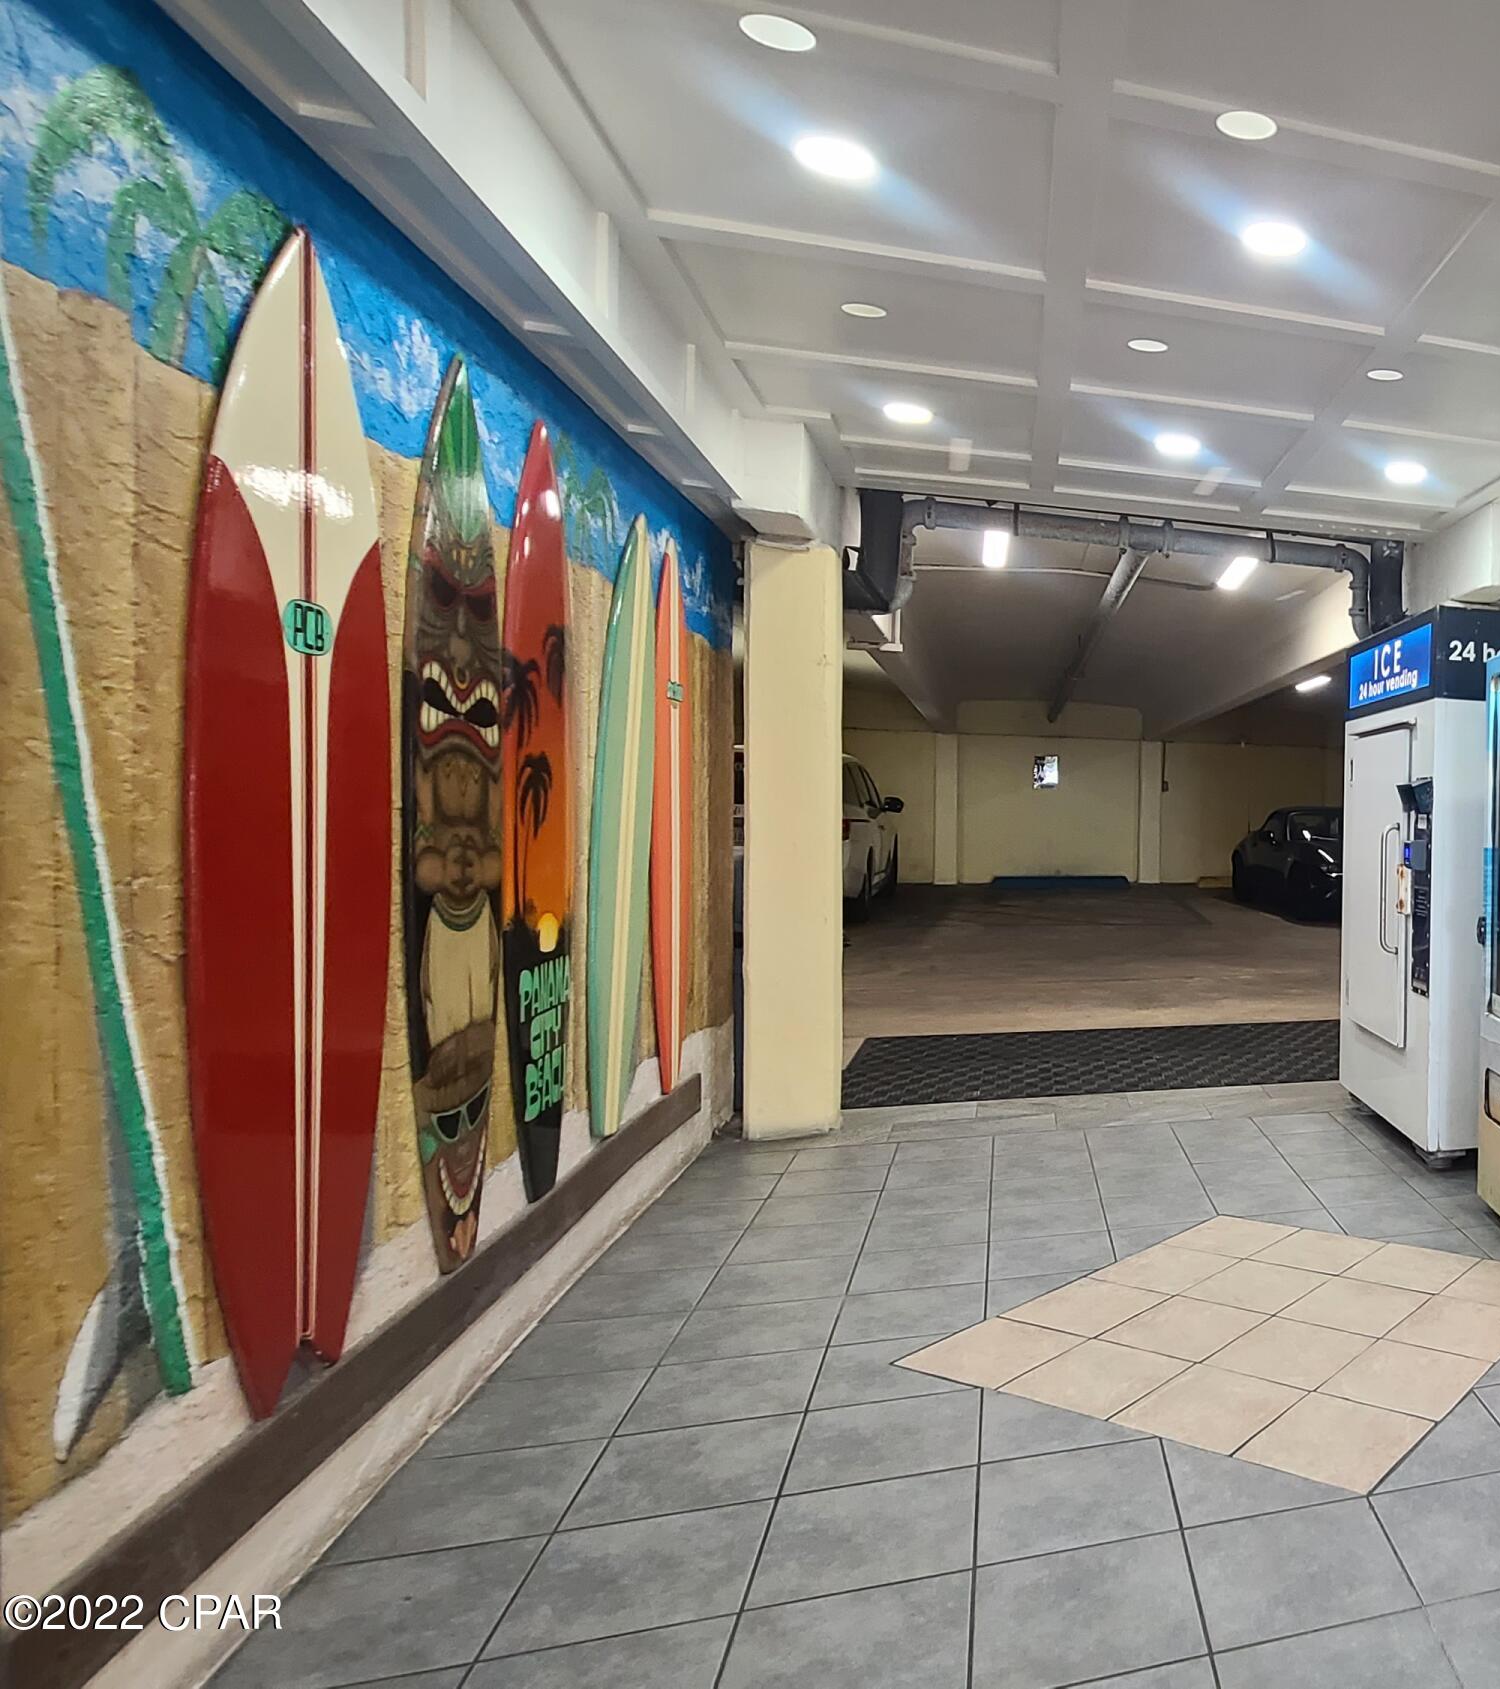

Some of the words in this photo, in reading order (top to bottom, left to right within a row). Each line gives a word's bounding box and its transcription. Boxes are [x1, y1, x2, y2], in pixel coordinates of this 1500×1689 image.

[293, 603, 325, 652] PCB
[1374, 639, 1402, 680] ICE
[1448, 640, 1476, 662] 24
[1359, 682, 1368, 701] 24
[1368, 681, 1385, 698] hour
[1386, 668, 1418, 692] vending
[519, 954, 571, 1023] PANAMA
[530, 1004, 562, 1060] CITY
